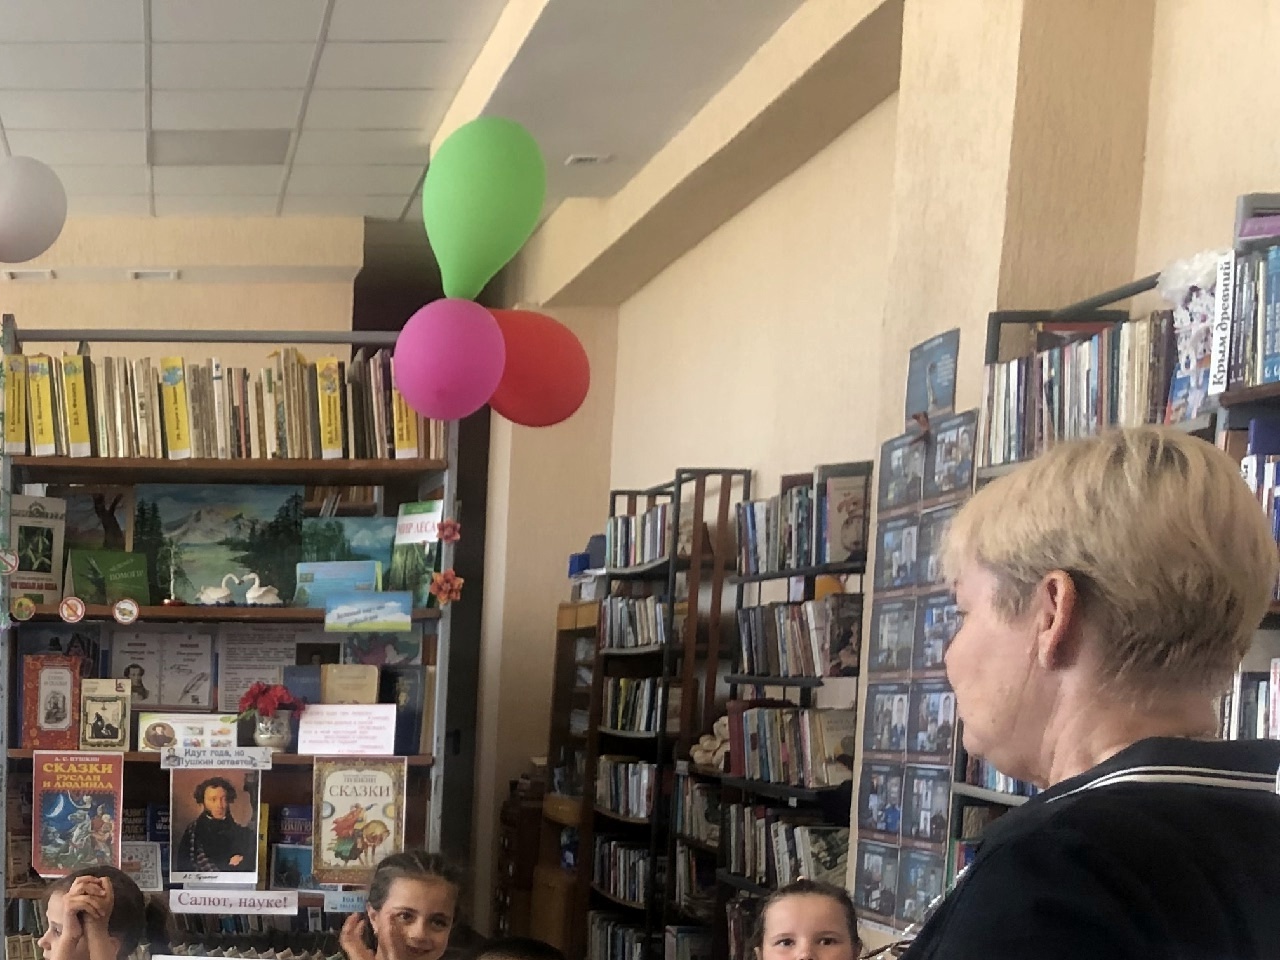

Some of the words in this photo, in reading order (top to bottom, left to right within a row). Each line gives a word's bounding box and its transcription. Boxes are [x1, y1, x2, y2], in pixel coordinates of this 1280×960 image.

[1216, 261, 1231, 331] древний
[1212, 336, 1227, 386] Крым
[398, 522, 413, 534] МИР
[415, 521, 437, 532] ЛЕСА
[184, 748, 206, 758] Идут
[210, 749, 231, 757] года,
[235, 749, 245, 757] но
[42, 763, 113, 774] СКАЗКИ
[179, 757, 213, 767] Пушкин
[329, 784, 390, 797] СКАЗКИ
[178, 892, 232, 907] Салют,
[238, 896, 288, 908] науке!
